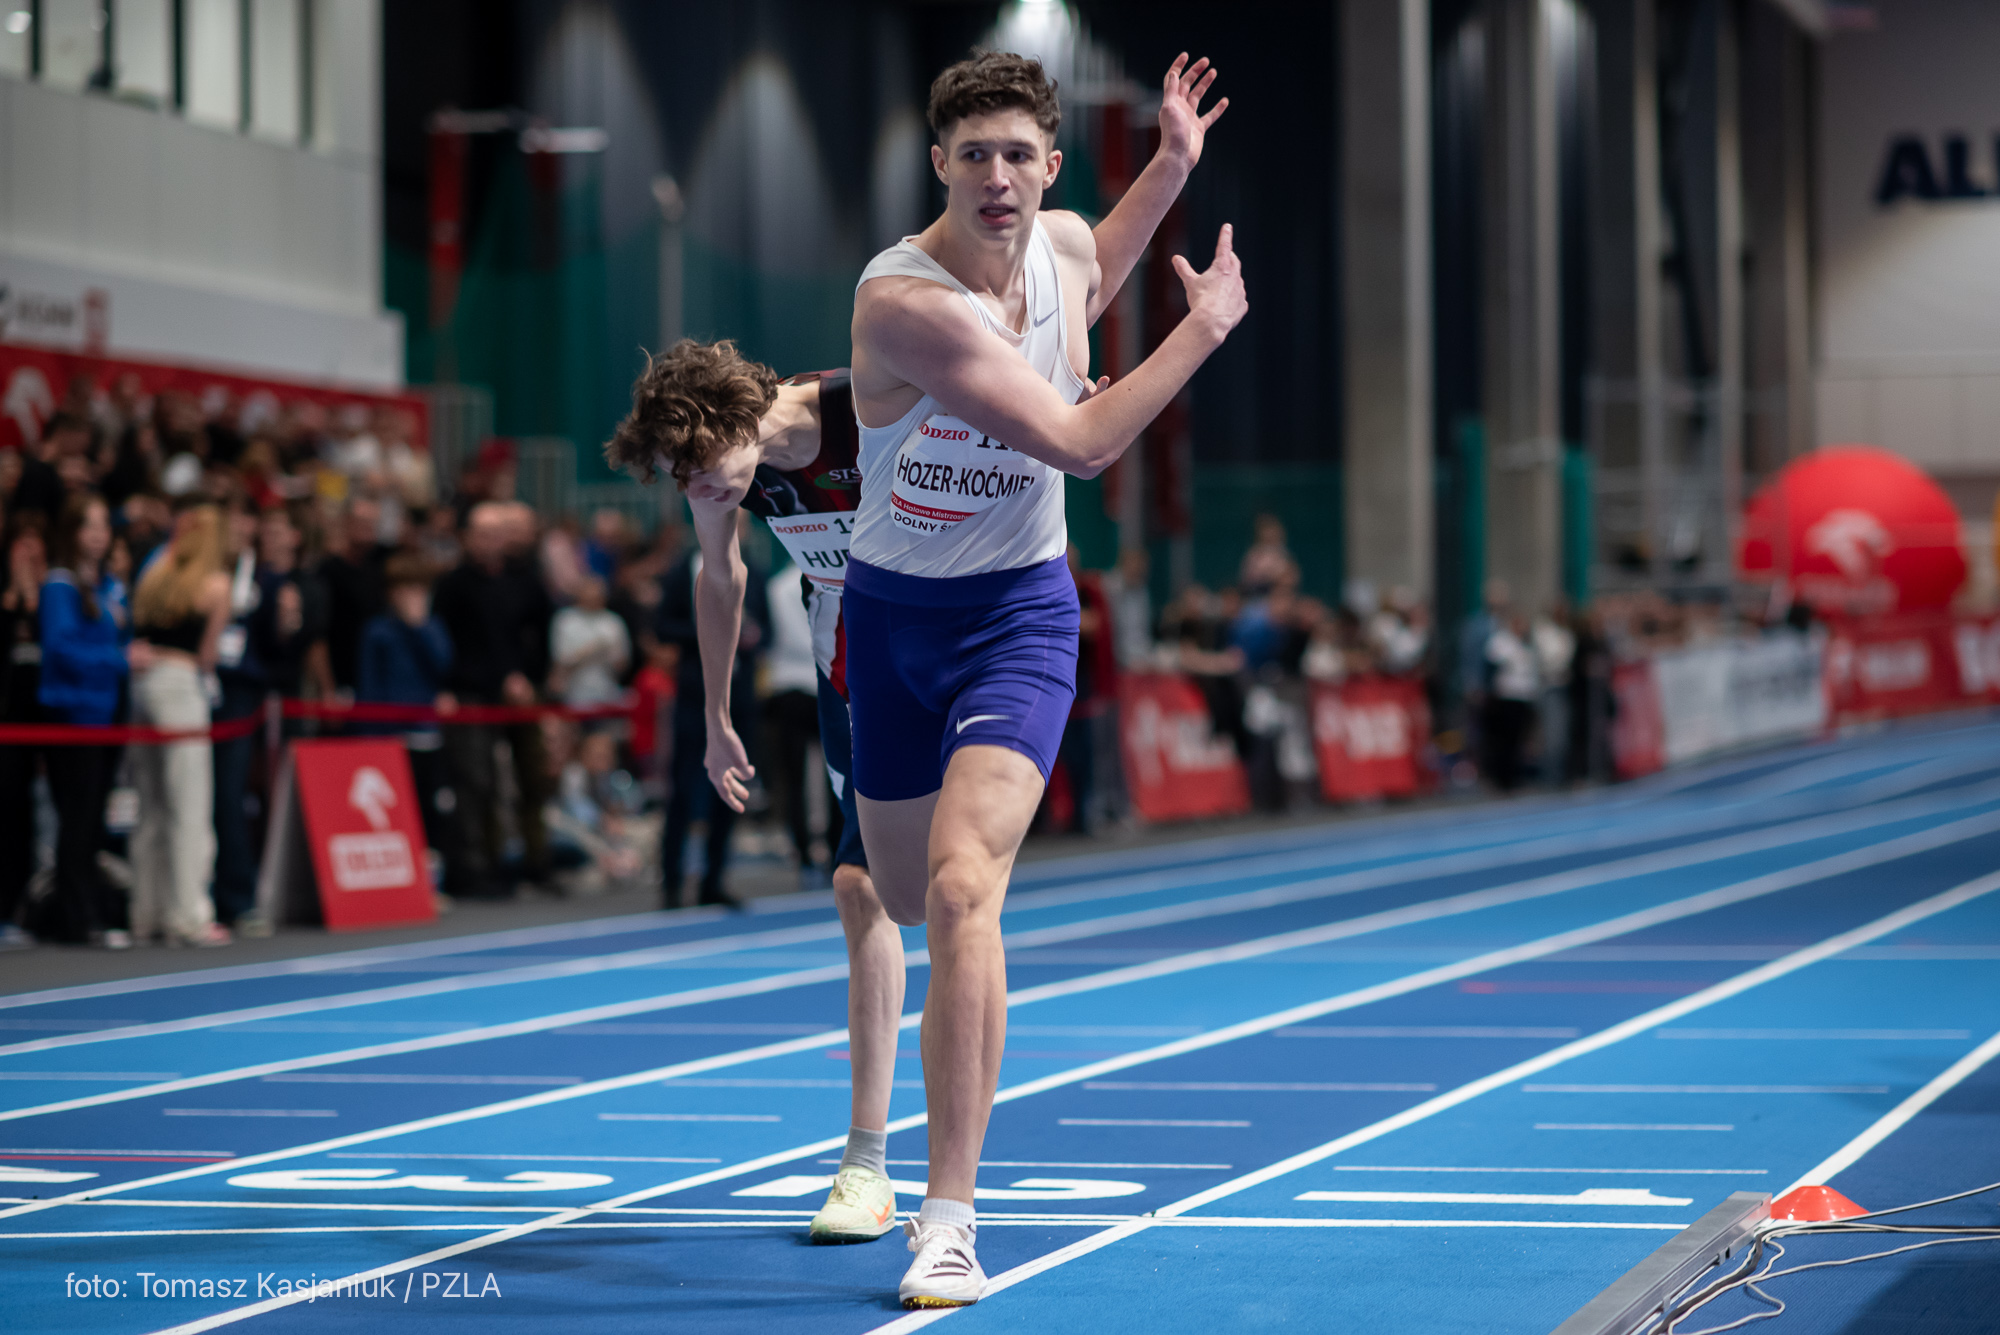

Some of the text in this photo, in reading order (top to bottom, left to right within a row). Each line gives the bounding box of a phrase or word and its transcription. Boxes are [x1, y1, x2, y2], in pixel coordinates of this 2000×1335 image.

[1875, 133, 2000, 204] AL
[897, 453, 1035, 499] HOZER-KOĆMIE
[903, 503, 931, 516] Halowe
[774, 523, 829, 534] BODZIO
[894, 511, 938, 532] DOLNY
